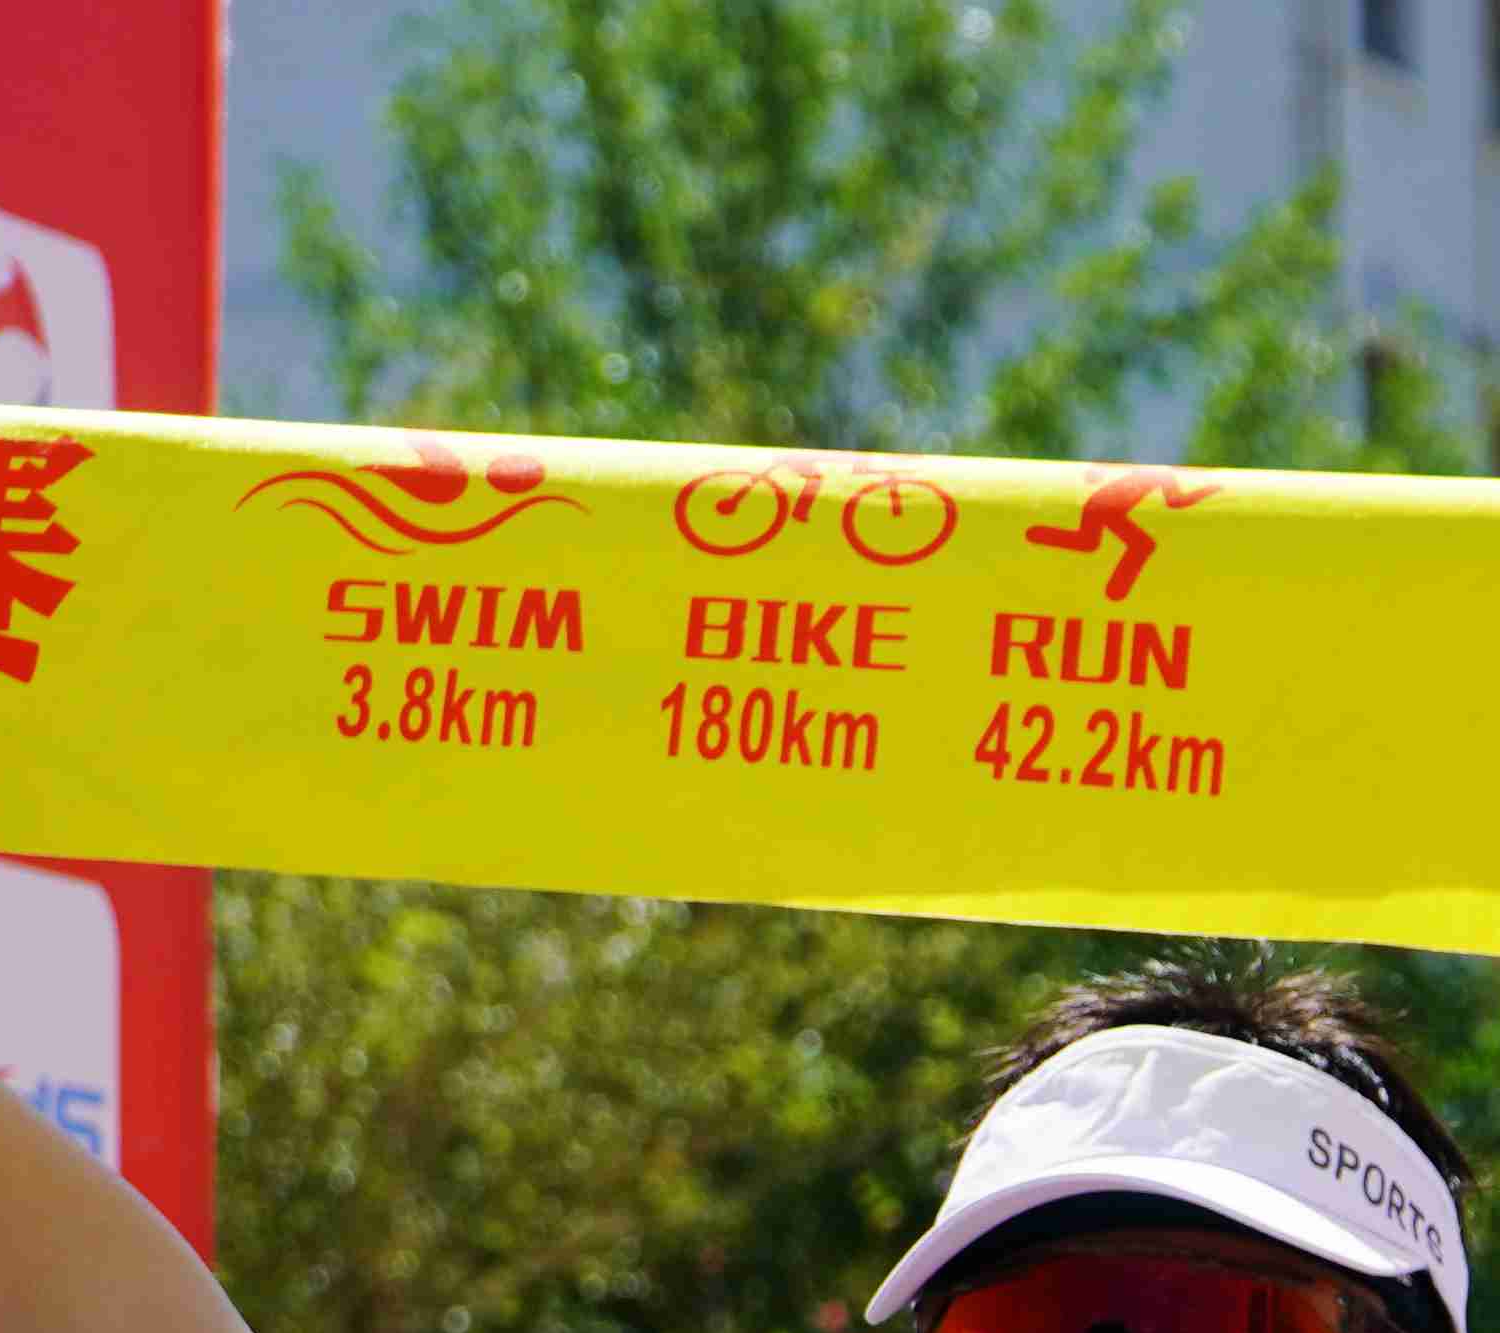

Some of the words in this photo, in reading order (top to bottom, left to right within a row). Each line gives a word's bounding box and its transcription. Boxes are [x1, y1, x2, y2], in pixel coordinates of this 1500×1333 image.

[323, 576, 586, 655] SWIM
[683, 595, 911, 672] BIKE
[988, 612, 1193, 690] RUN
[335, 663, 539, 749] 3.8km
[658, 681, 880, 772] 180km
[973, 703, 1227, 798] 42.2km
[1307, 1127, 1446, 1266] SPORTS
